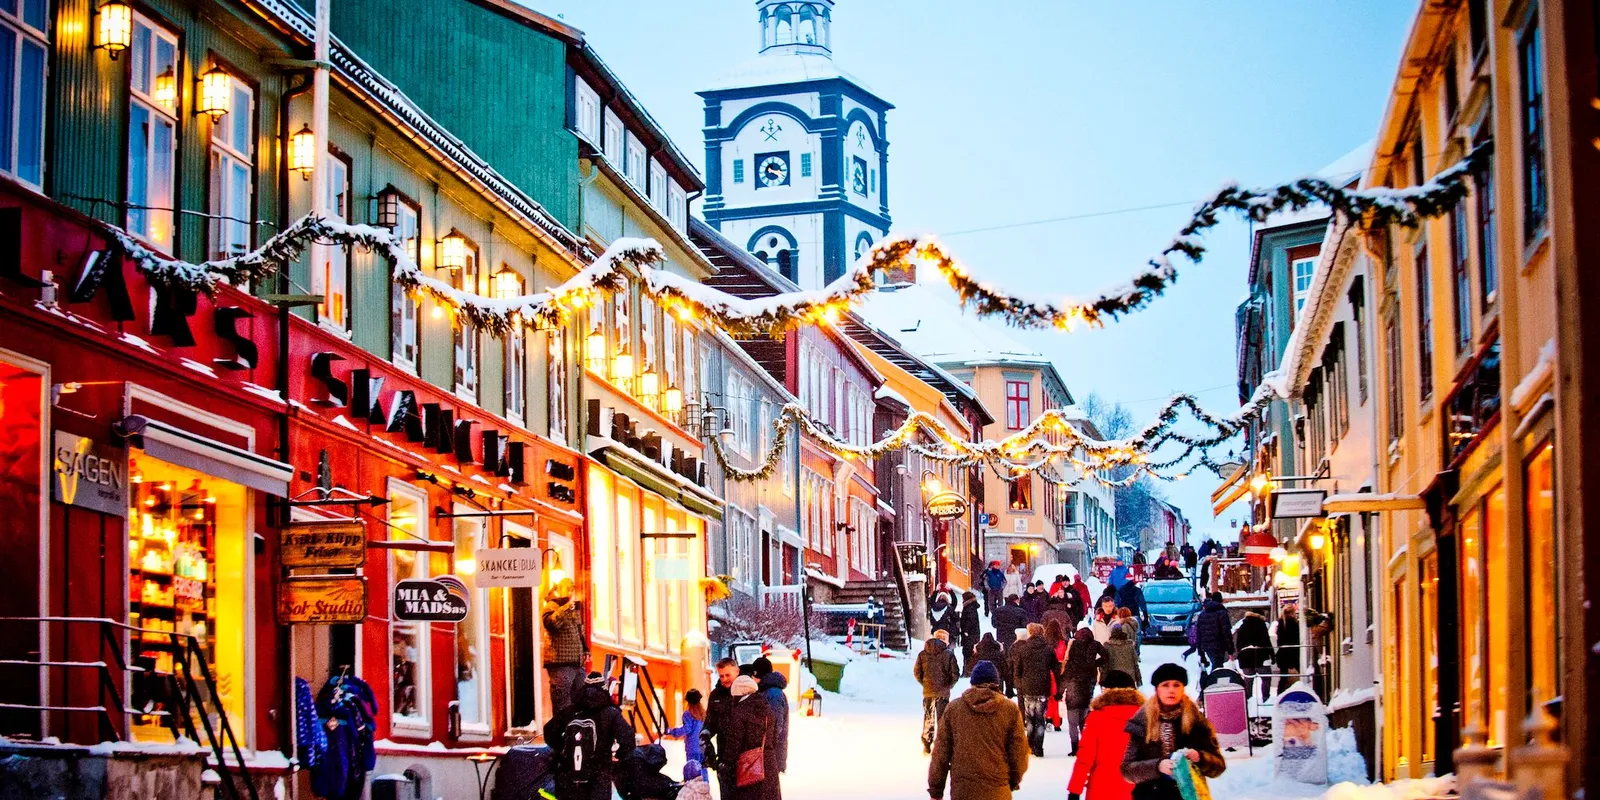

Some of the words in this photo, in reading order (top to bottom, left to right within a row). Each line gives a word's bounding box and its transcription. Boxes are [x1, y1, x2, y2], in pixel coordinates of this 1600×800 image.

[311, 352, 530, 486] SKANCKE
[481, 559, 517, 571] SKANCKE
[521, 559, 536, 570] BUA
[397, 588, 430, 601] MIA
[433, 588, 448, 601] &
